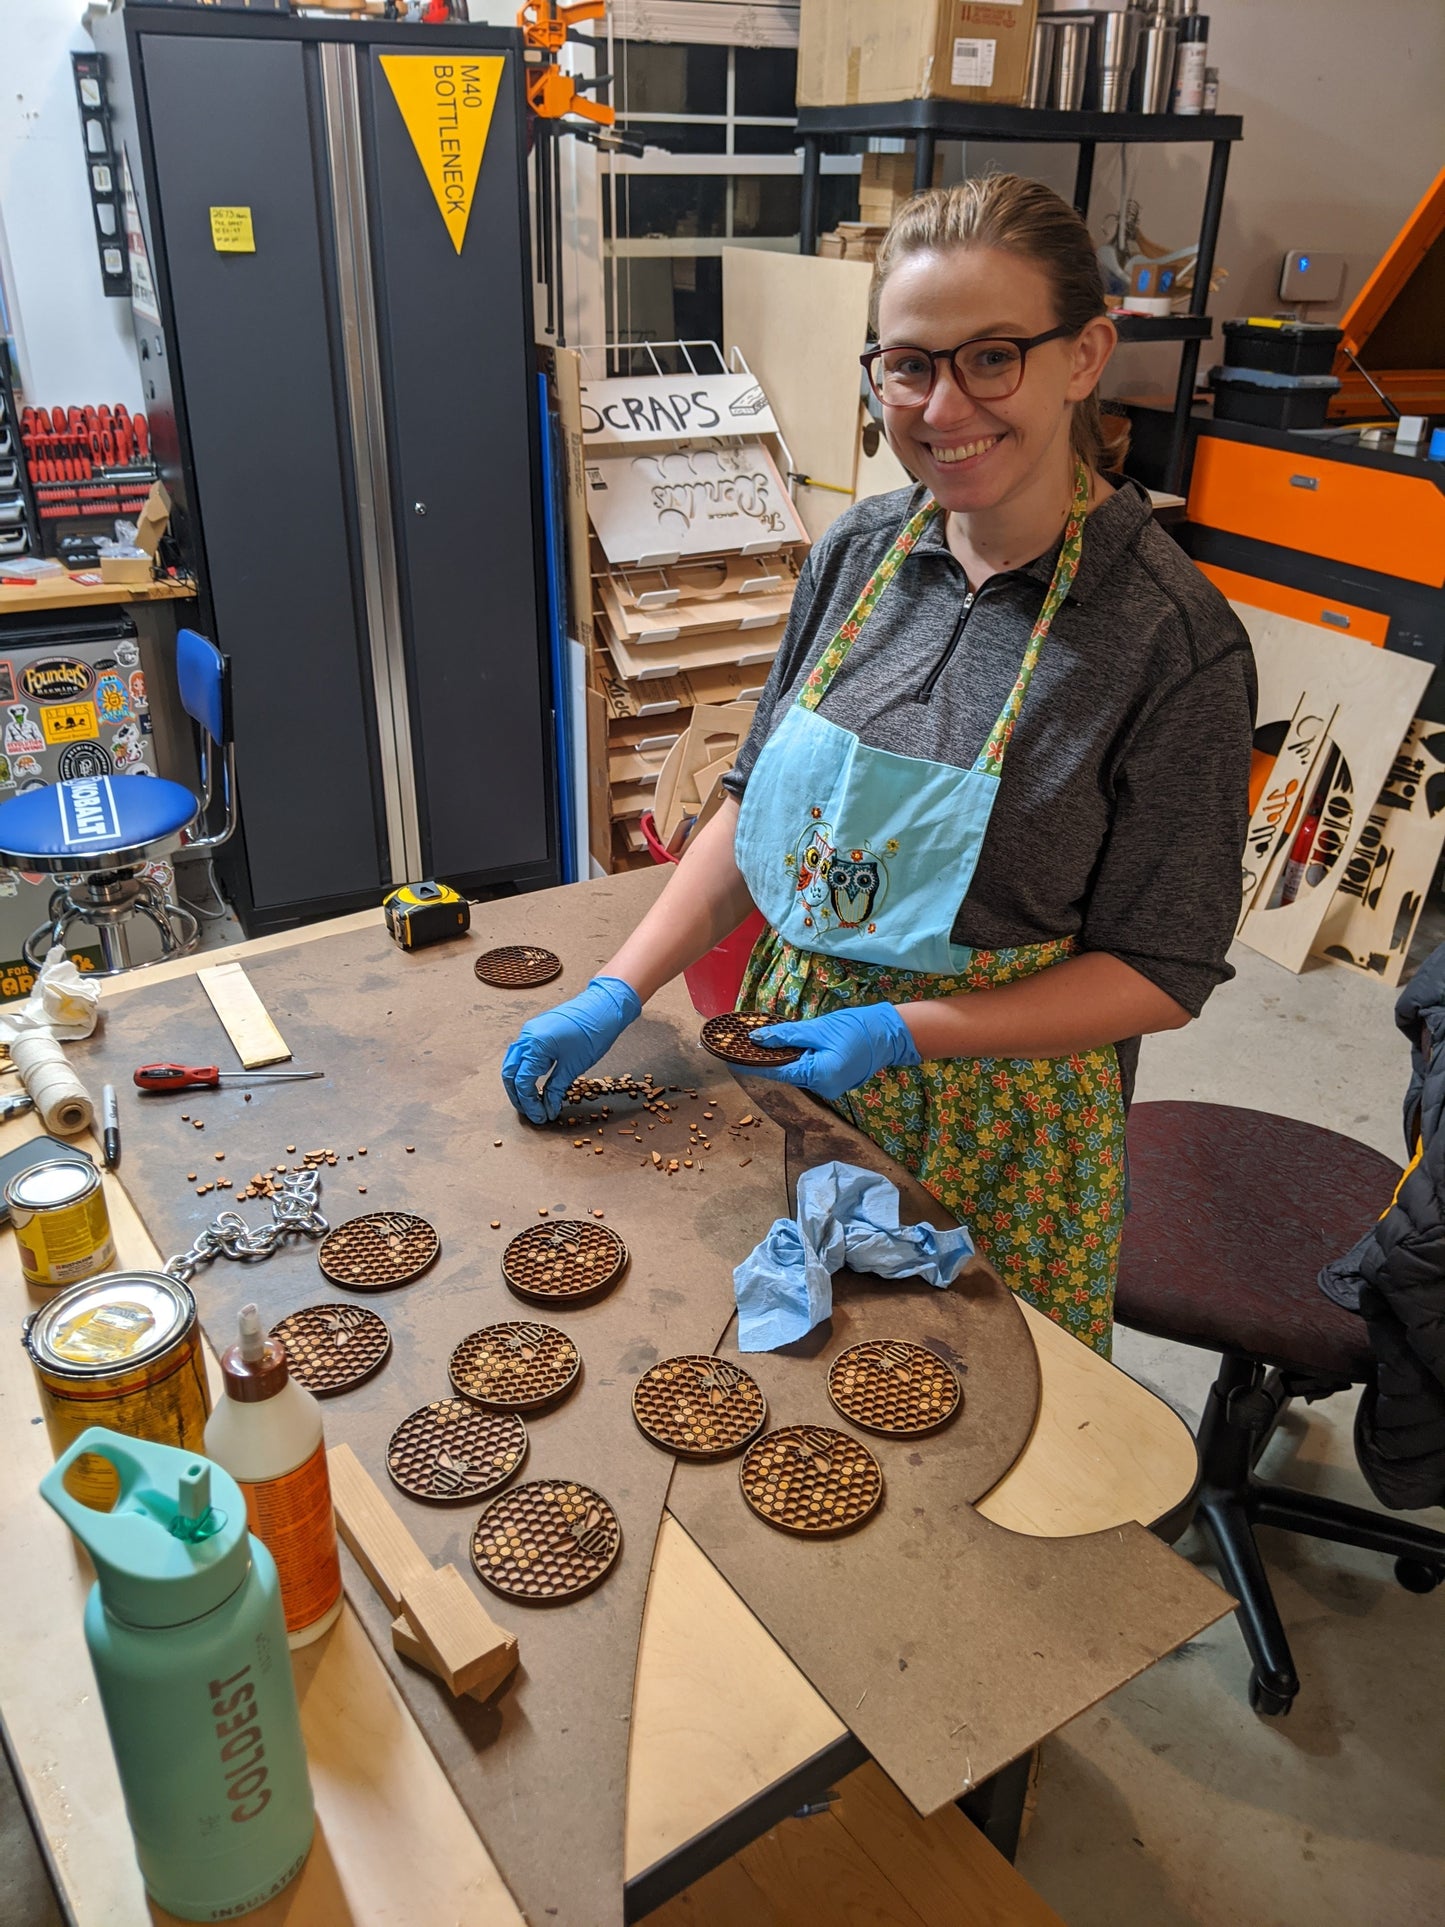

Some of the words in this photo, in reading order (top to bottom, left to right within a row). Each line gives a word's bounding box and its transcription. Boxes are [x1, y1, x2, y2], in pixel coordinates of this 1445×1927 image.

[461, 65, 482, 108] M40
[434, 65, 465, 214] BOTTLENECK
[71, 783, 107, 834] KOBALT
[7, 965, 29, 977] FOR
[208, 1665, 272, 1823] COLDEST
[210, 1855, 304, 1920] INSULATED
